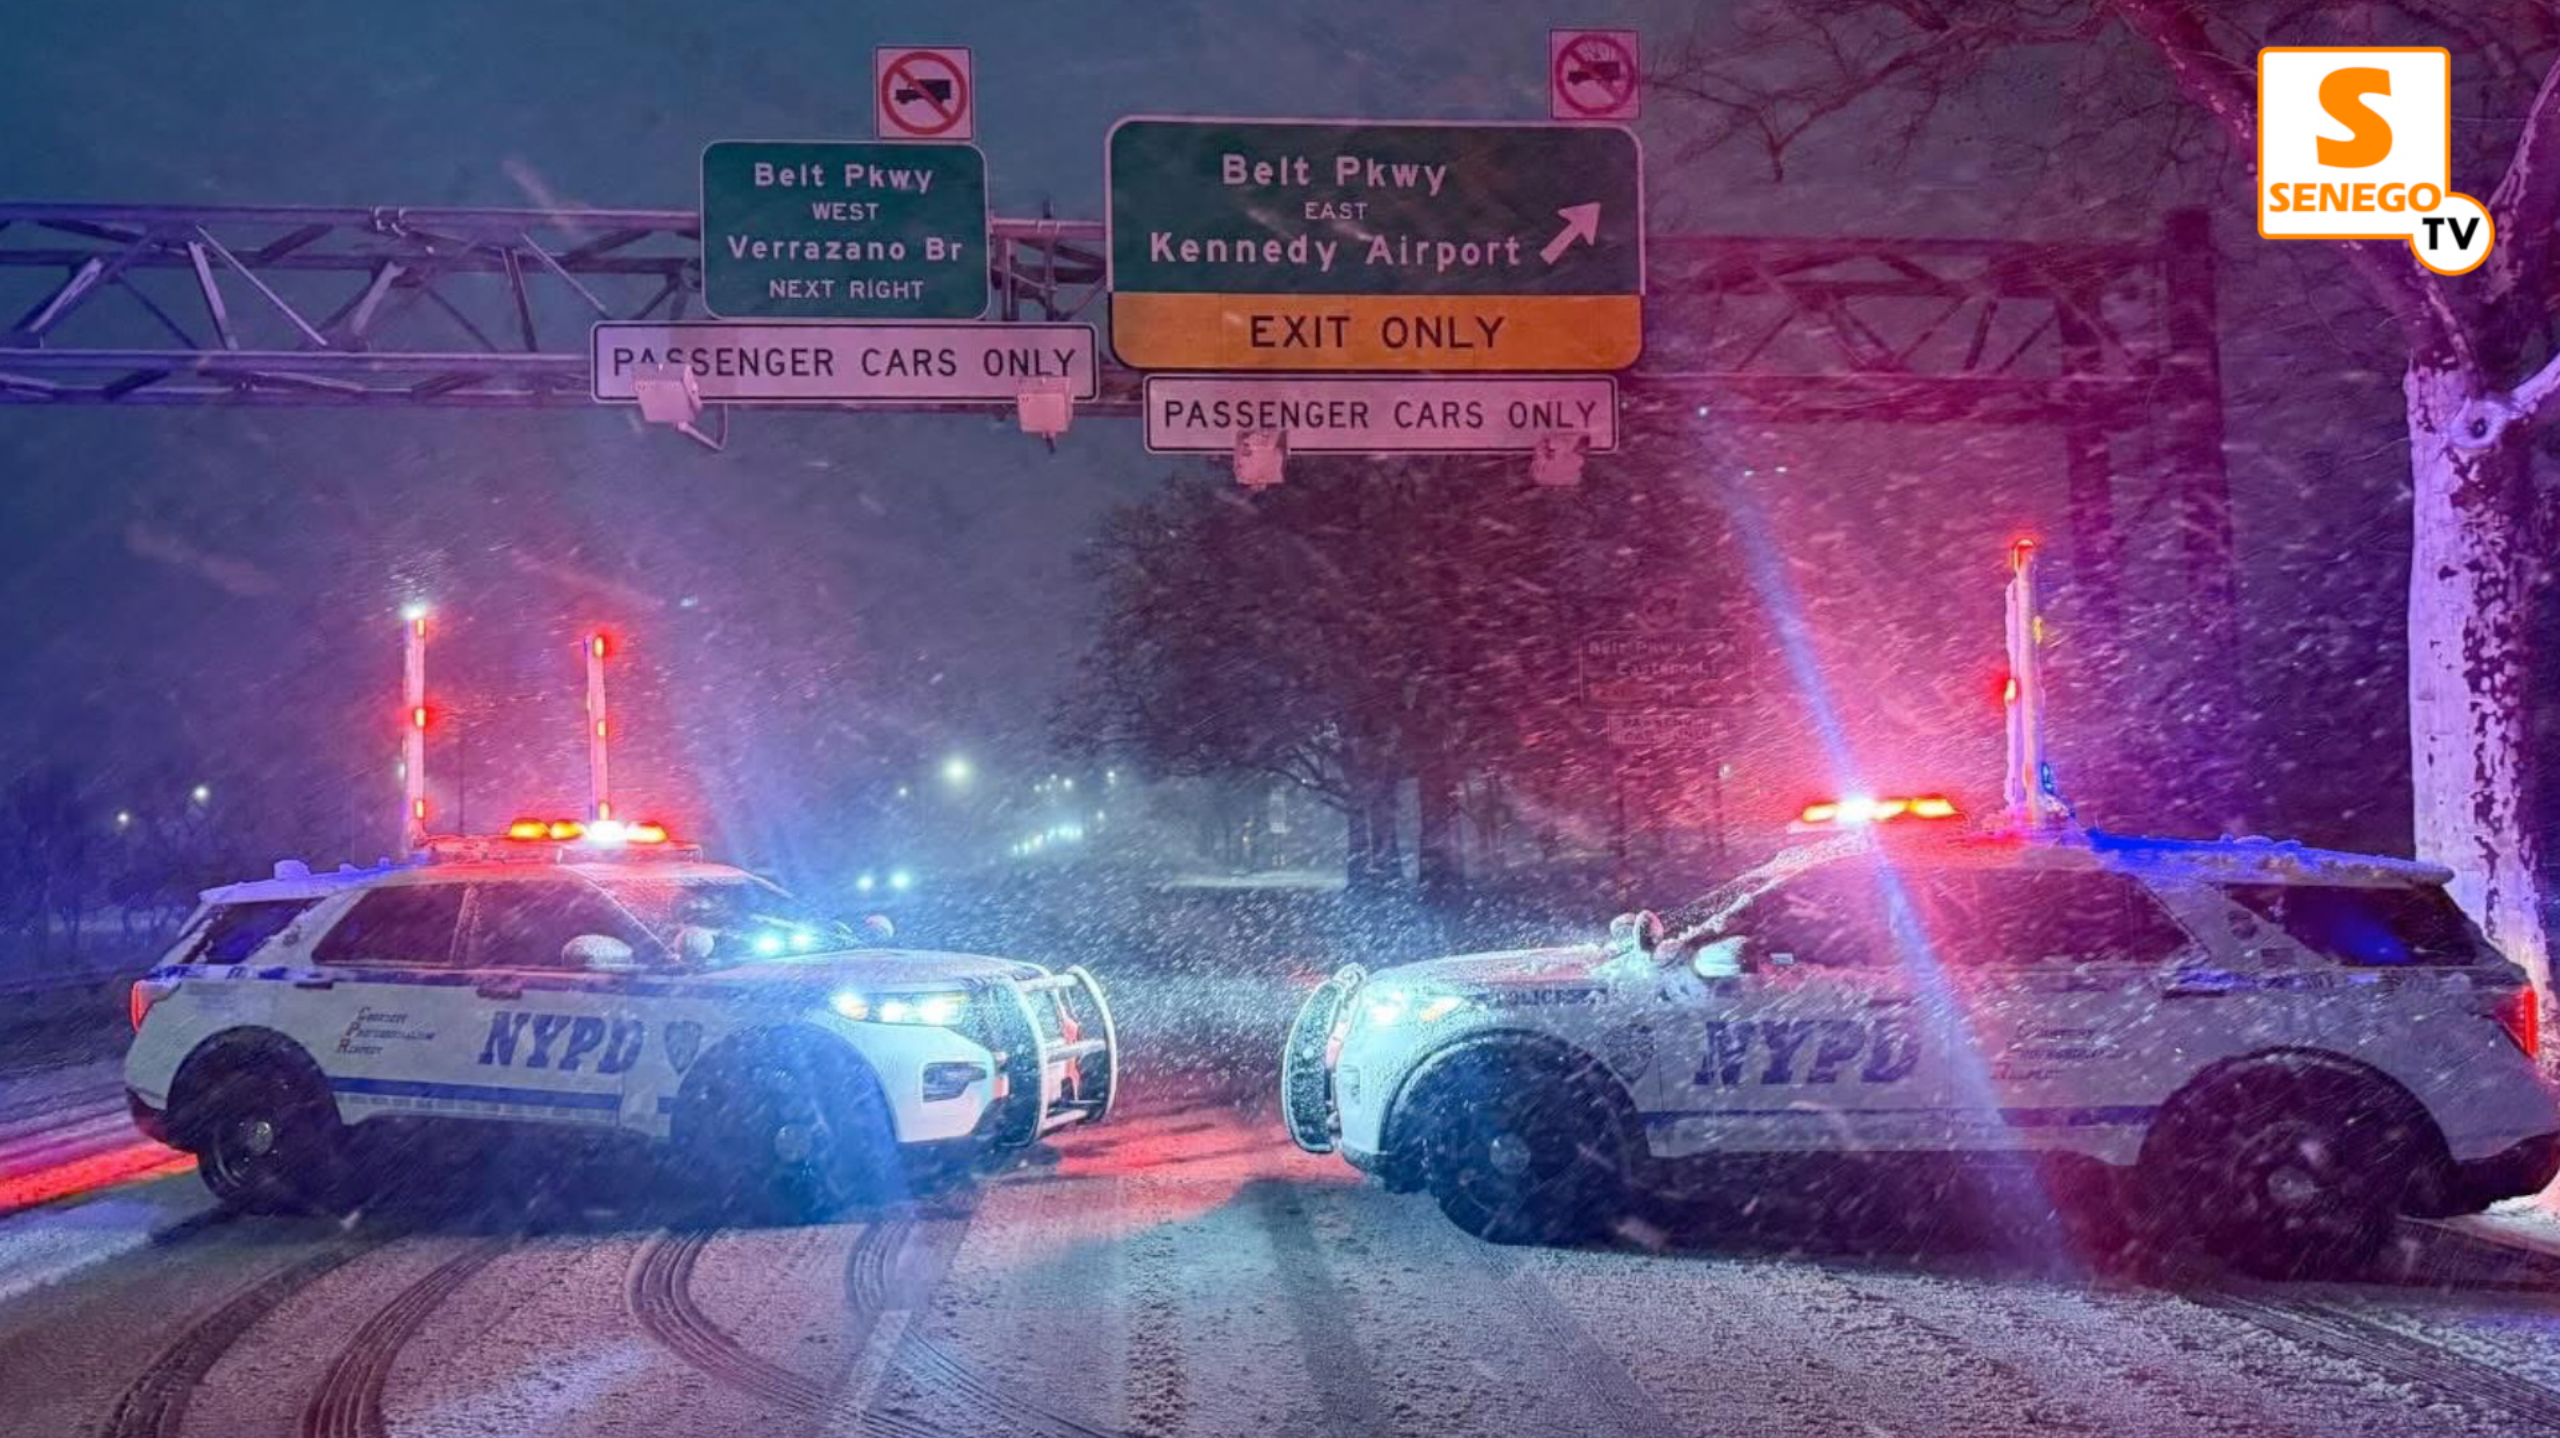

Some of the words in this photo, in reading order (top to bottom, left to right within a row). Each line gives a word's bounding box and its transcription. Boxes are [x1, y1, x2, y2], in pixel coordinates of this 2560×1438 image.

[754, 162, 826, 188] Belt
[844, 163, 934, 195] Pkwy
[1222, 154, 1311, 187] Belt
[1336, 156, 1447, 196] Pkwy
[812, 202, 880, 222] WEST
[1305, 202, 1368, 221] EAST
[727, 234, 907, 263] Verrazano
[924, 235, 964, 263] Br
[1150, 231, 1338, 272] Kennedy
[1365, 234, 1521, 273] Airport
[768, 279, 835, 299] NEXT
[849, 280, 925, 300] RIGHT
[1250, 315, 1351, 348] EXIT
[1382, 315, 1506, 349] ONLY
[613, 347, 835, 377] PASSENGER
[861, 348, 958, 377] CARS
[983, 348, 1078, 377] ONLY
[1163, 400, 1369, 429] PASSENGER
[1394, 400, 1484, 429] CARS
[1508, 401, 1599, 429] ONLY
[478, 1010, 645, 1075] NYPD
[1691, 1020, 1922, 1086] NYPD
